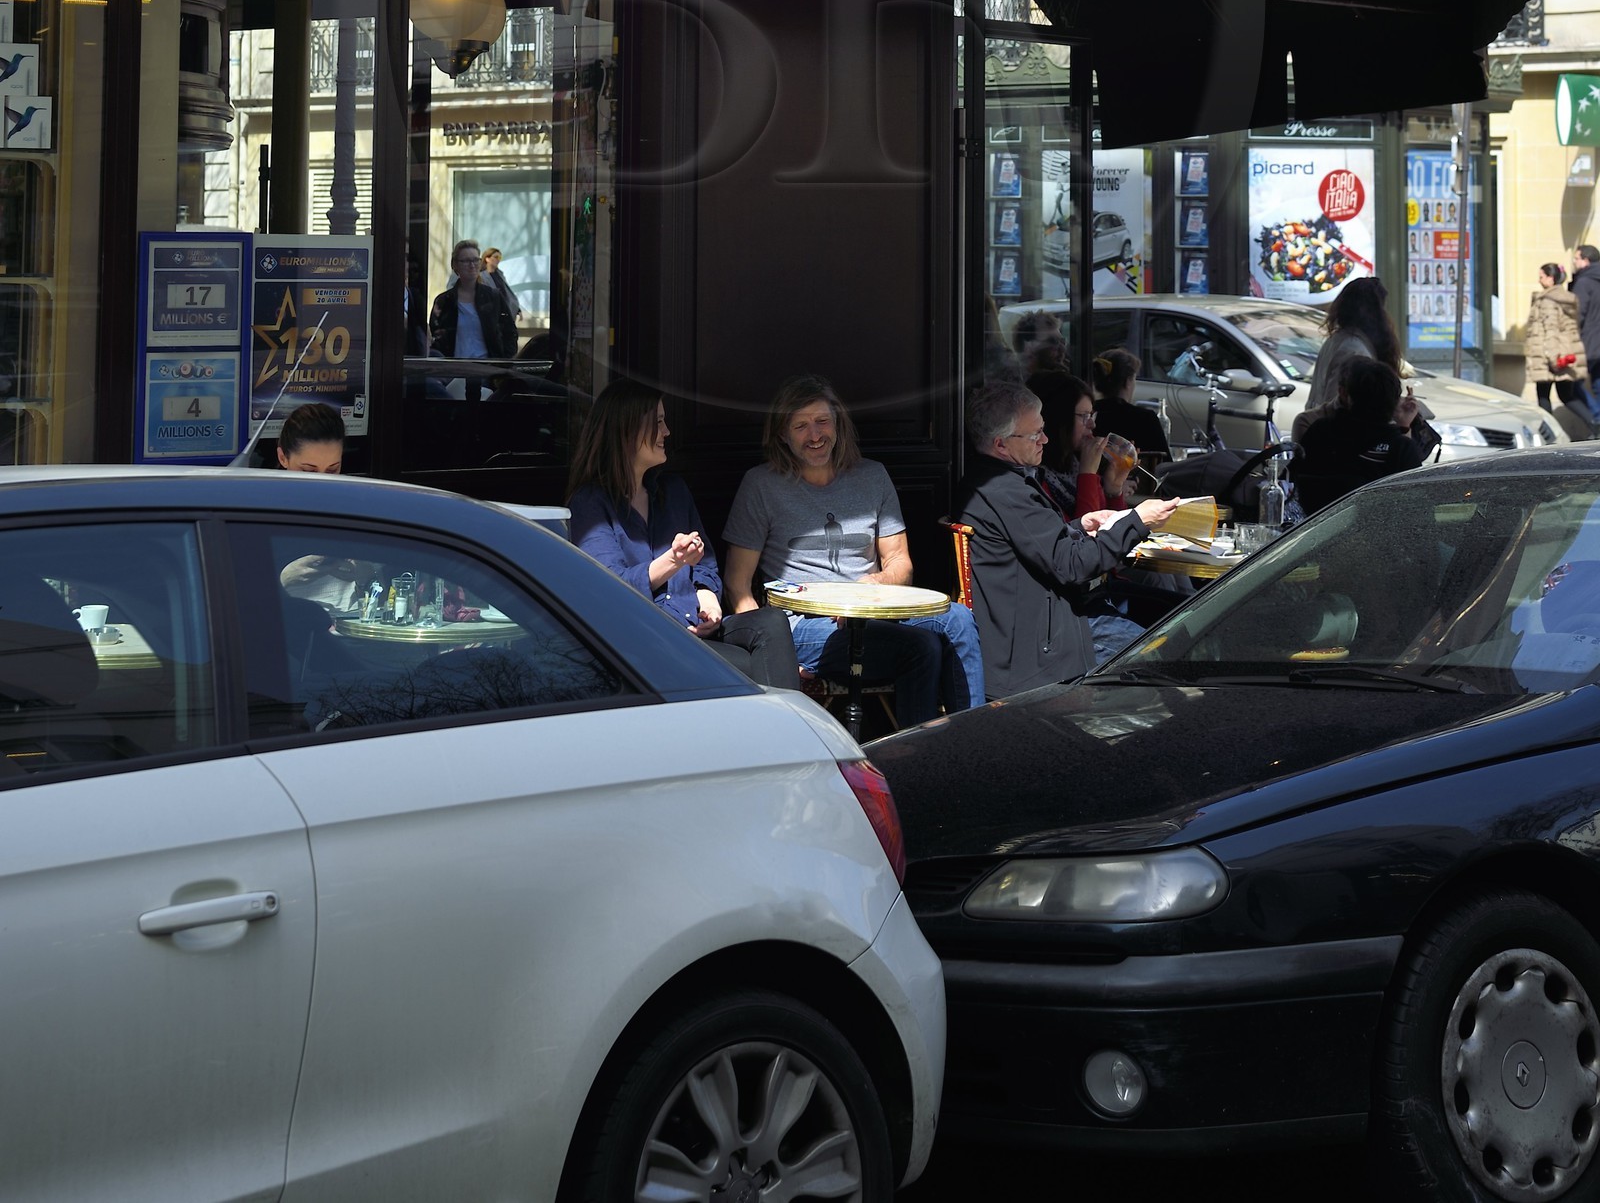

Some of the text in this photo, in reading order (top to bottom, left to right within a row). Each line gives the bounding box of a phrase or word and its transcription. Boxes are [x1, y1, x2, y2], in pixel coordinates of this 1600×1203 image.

[443, 119, 552, 138] BNP PARIBA
[1284, 120, 1338, 137] Presse
[1093, 166, 1131, 176] orever
[1253, 161, 1314, 176] picard
[280, 257, 353, 266] EUROMILLIONS
[185, 286, 212, 306] 17
[160, 312, 228, 325] MILLIONS €
[279, 326, 351, 365] 130
[171, 362, 214, 378] LOTO
[281, 369, 348, 382] MILLIONS
[187, 398, 202, 418] 4
[158, 425, 225, 438] MILLIONS €
